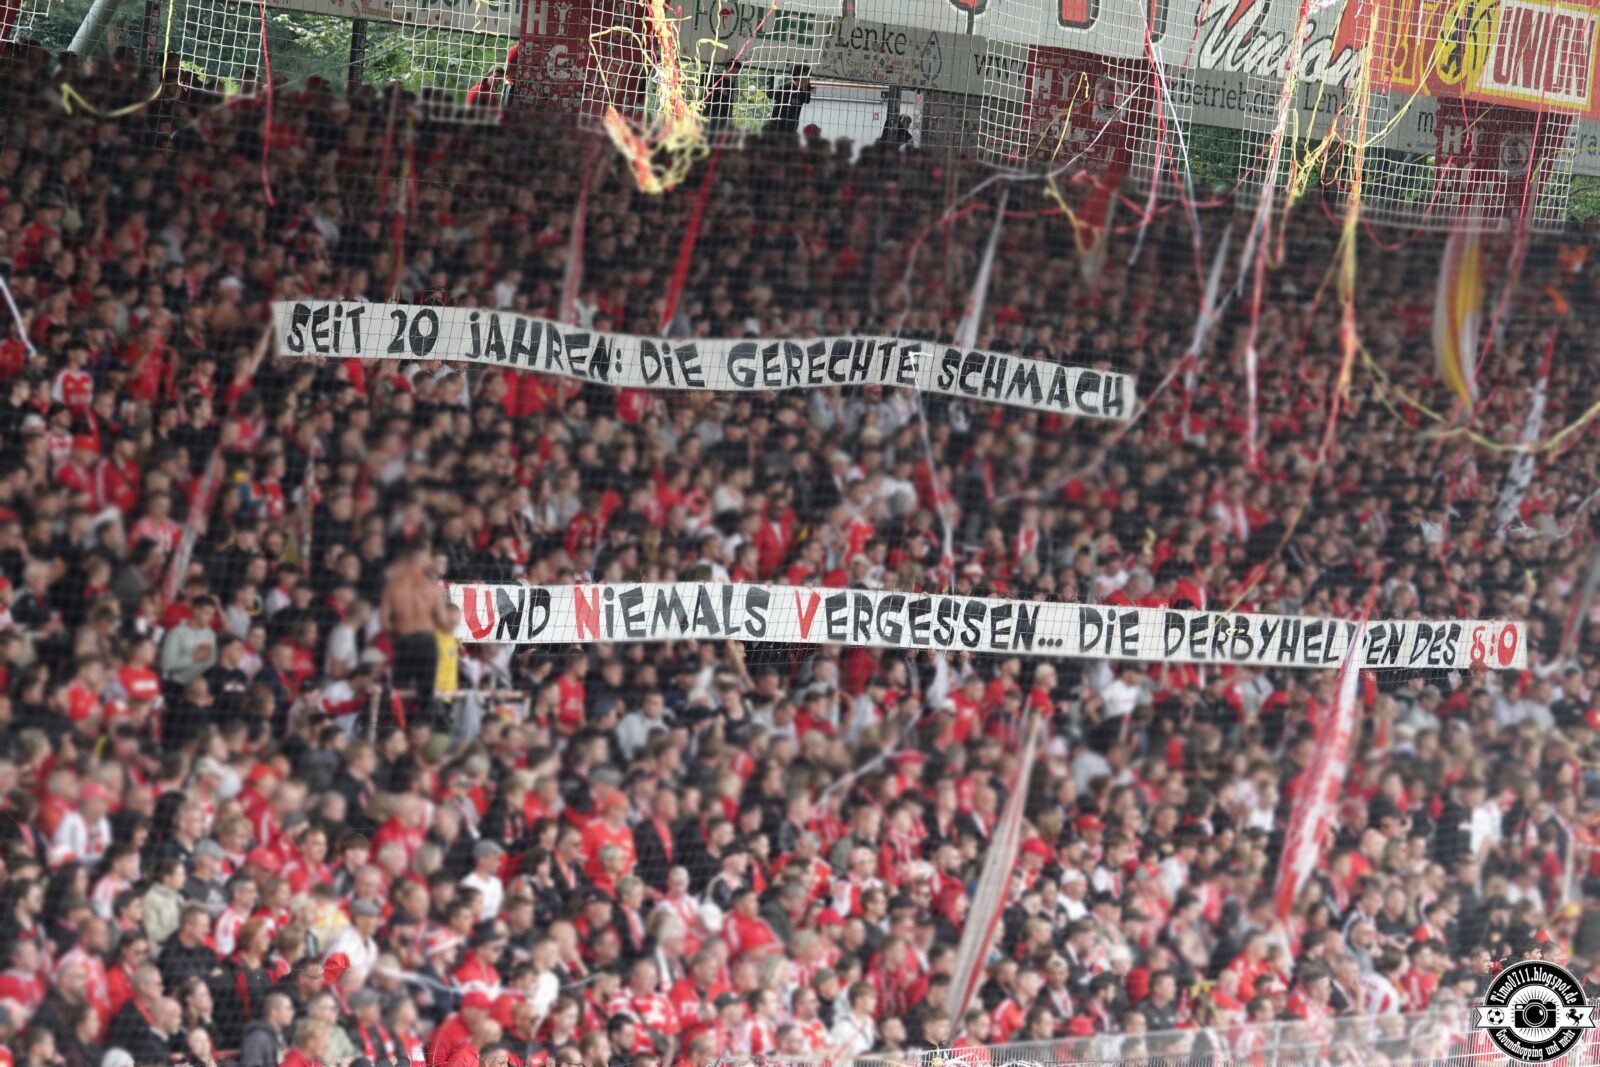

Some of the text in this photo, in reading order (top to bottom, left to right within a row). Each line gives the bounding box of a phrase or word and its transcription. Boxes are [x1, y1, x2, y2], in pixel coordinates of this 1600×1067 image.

[834, 17, 907, 55] Lenke
[1493, 6, 1596, 97] UNION
[388, 308, 439, 356] 20
[727, 339, 922, 387] GERECHTE
[938, 348, 1124, 417] SCHMACH
[463, 588, 551, 640] UND
[795, 590, 1063, 648] VERGESSEN...
[1408, 623, 1462, 666] DES
